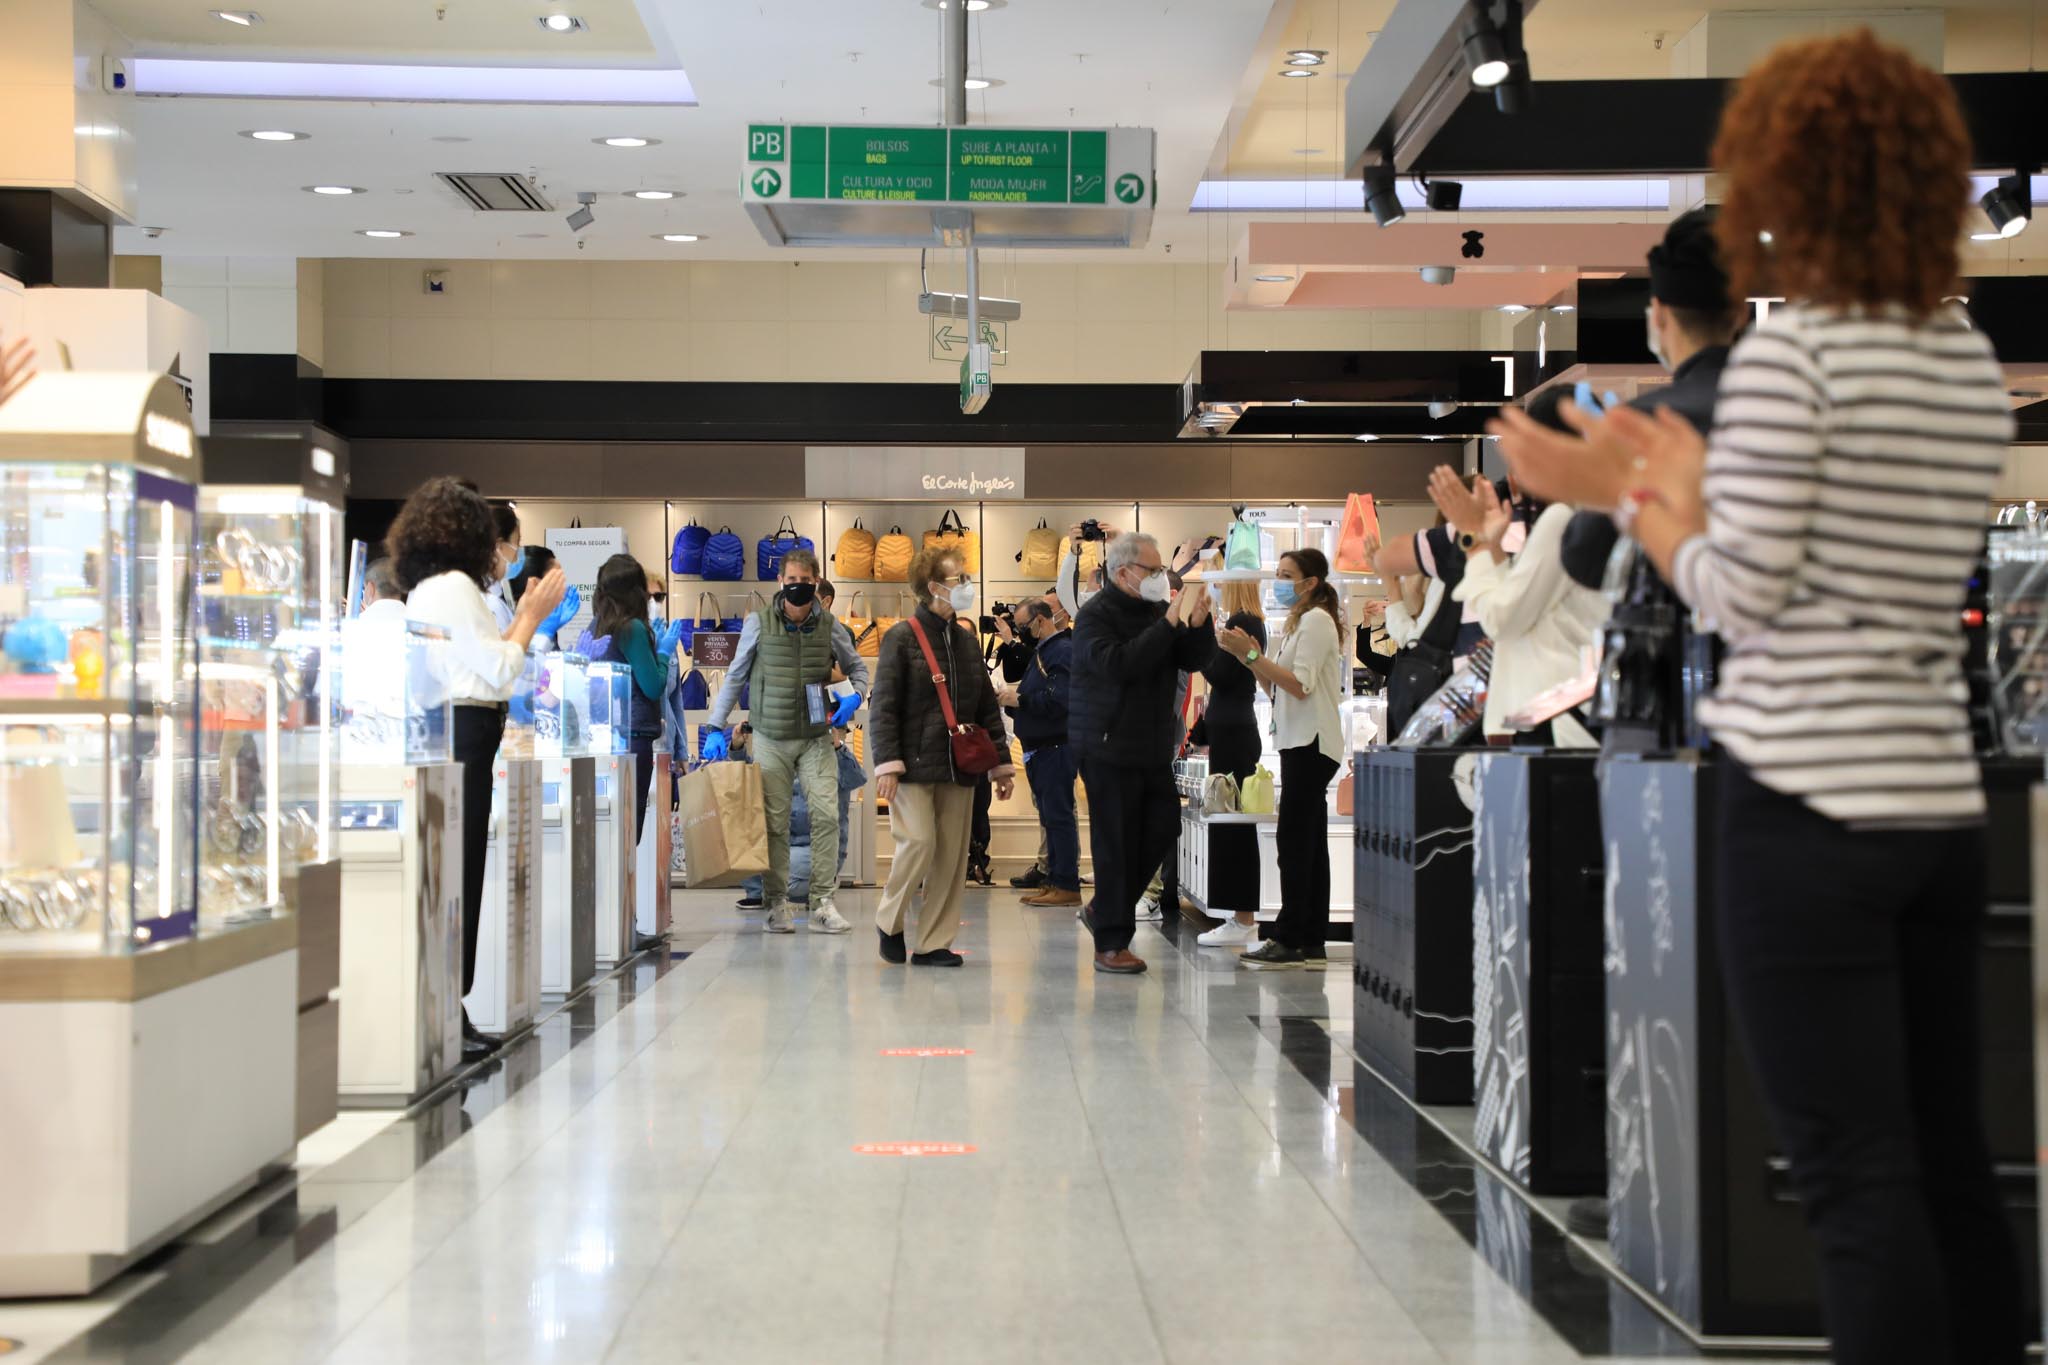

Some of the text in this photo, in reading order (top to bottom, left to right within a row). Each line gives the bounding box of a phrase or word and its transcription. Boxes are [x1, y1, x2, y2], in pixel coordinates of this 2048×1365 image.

[752, 132, 781, 155] PB
[866, 140, 910, 152] BOLSOS
[962, 142, 990, 153] SUBE
[994, 142, 1002, 153] A
[1006, 143, 1049, 154] PLANTA
[866, 154, 887, 164] BAGS
[961, 155, 1033, 166] UP TO FIRST FLOOR
[843, 176, 932, 188] CULTURA Y OCIO
[970, 178, 1047, 191] MODA MUJER
[843, 189, 916, 201] CULTURE & LEISURE
[976, 374, 987, 383] PB
[922, 471, 1015, 495] El Corte Inglés
